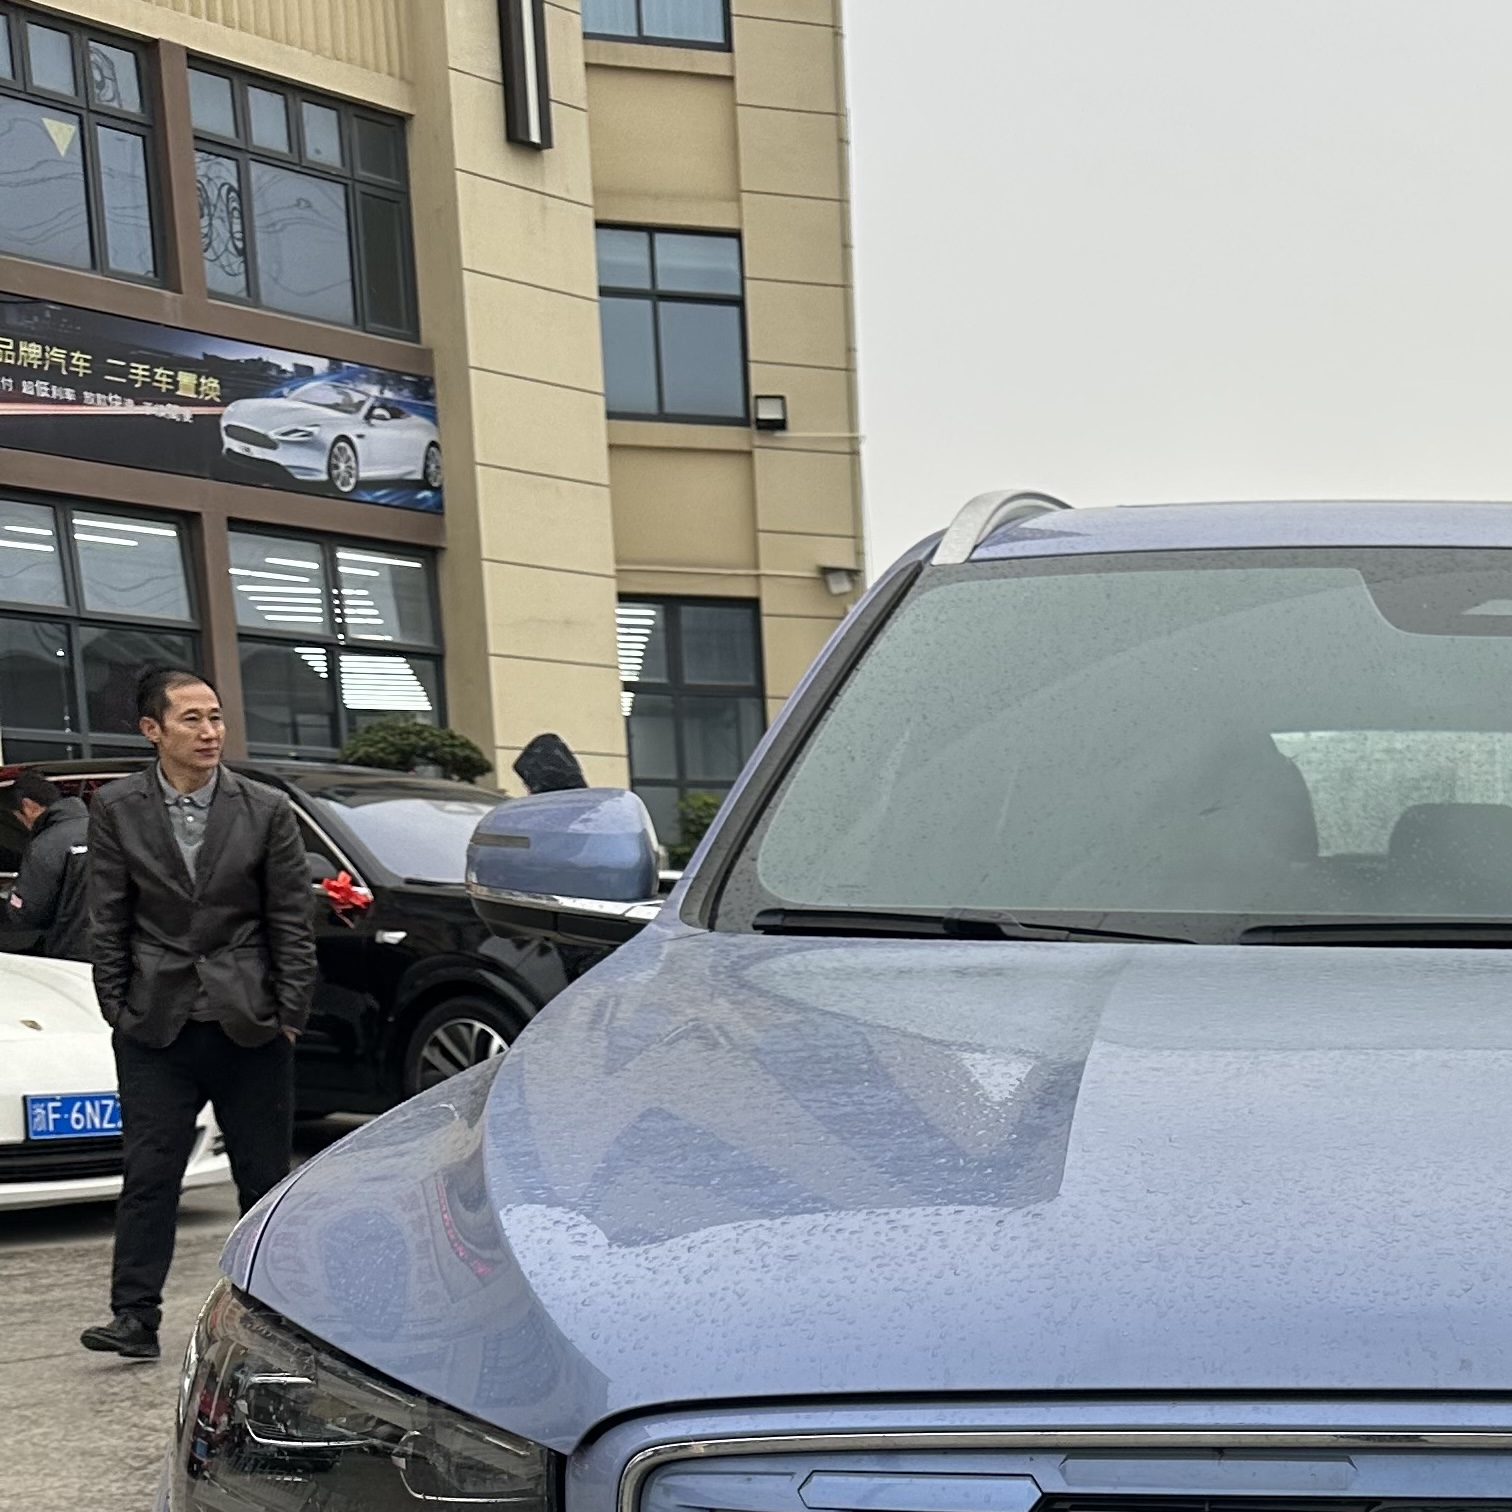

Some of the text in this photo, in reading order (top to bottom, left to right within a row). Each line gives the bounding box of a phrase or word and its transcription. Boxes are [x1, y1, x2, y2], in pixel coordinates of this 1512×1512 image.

[0, 336, 93, 377] 品牌汽车
[103, 358, 221, 402] 二手车置换
[31, 1100, 123, 1131] 浙F·6NZ
